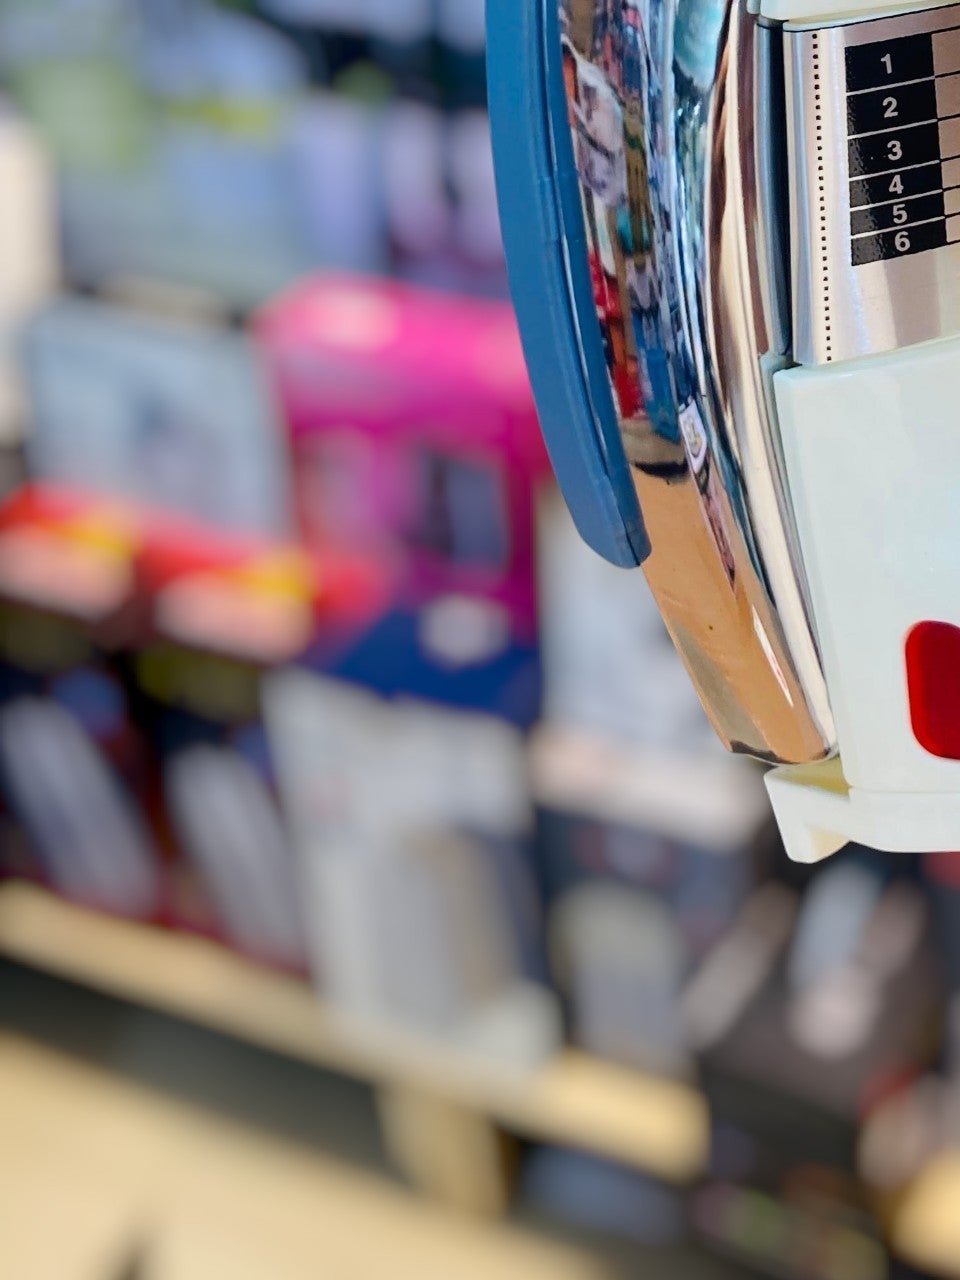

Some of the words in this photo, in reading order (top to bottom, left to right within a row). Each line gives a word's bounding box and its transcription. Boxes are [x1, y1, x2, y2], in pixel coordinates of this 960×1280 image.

[880, 53, 893, 74] 1
[882, 97, 898, 117] 2
[887, 140, 902, 161] 3
[888, 175, 903, 194] 4
[892, 204, 907, 223] 5
[894, 231, 911, 250] 6
